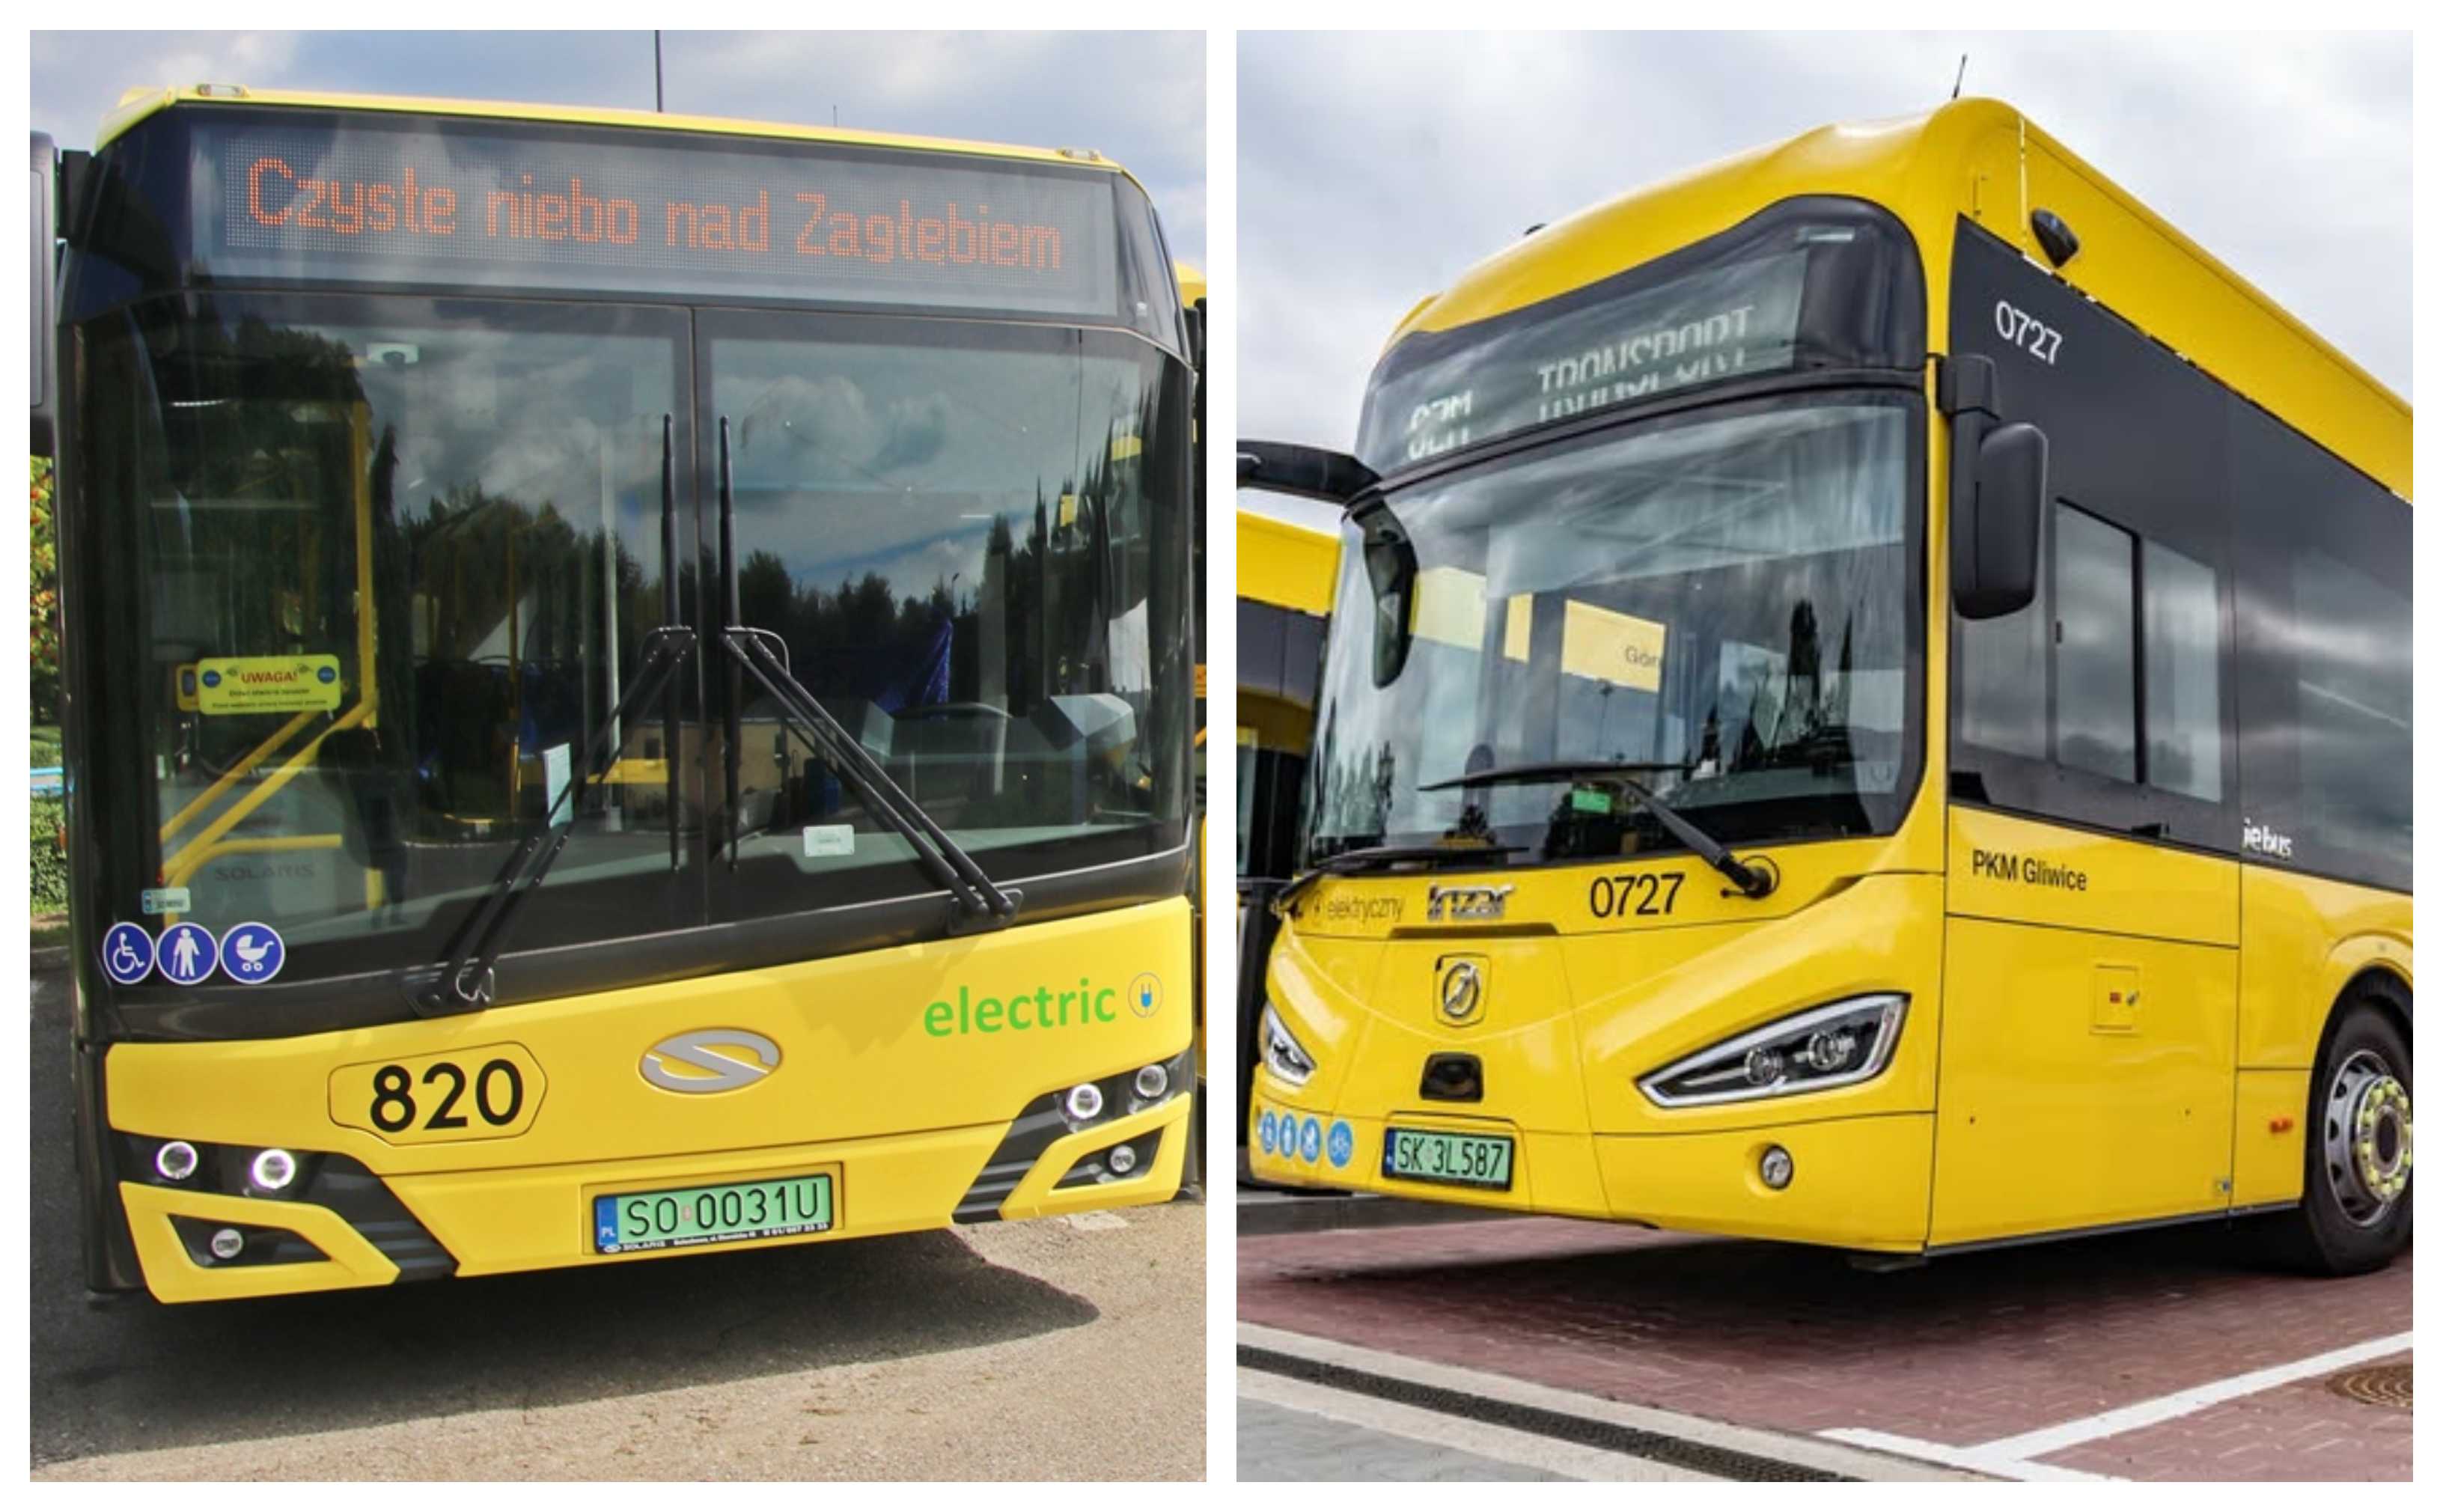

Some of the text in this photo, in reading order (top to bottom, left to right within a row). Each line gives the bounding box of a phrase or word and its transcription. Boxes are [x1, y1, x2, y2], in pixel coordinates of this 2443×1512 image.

[248, 157, 456, 234] Czyste
[487, 173, 639, 245] niebo
[666, 189, 770, 252] nad
[1995, 300, 2063, 365] 0727
[241, 671, 299, 685] UWAGA!
[1590, 871, 1686, 918] 0727
[1972, 849, 2087, 891] PKM Gliwice
[924, 978, 1117, 1037] electric
[370, 1058, 523, 1133] 820
[601, 1225, 617, 1238] PL
